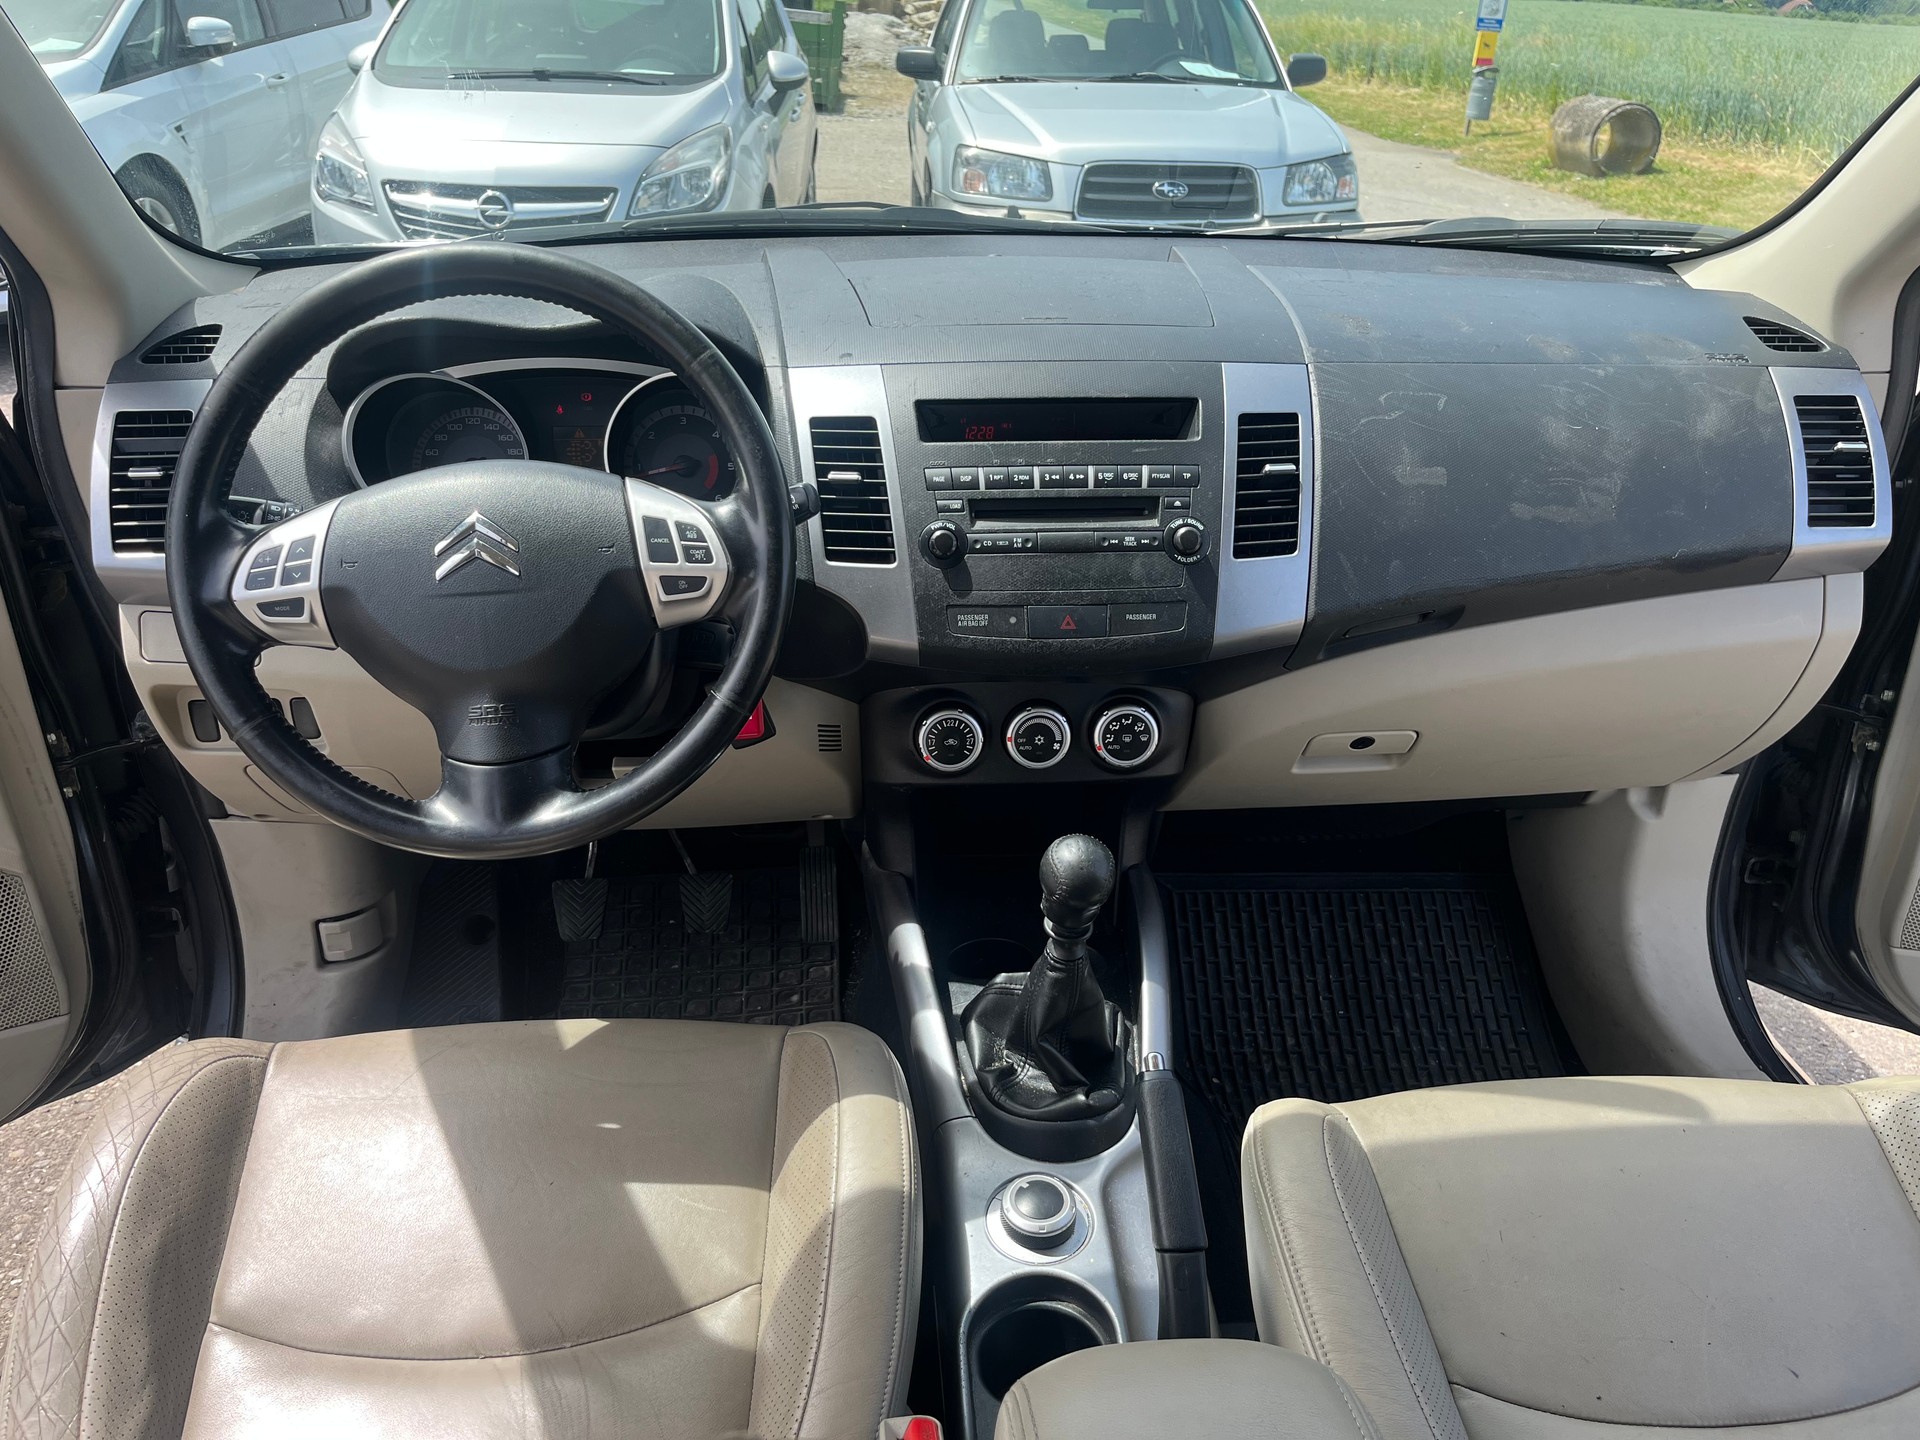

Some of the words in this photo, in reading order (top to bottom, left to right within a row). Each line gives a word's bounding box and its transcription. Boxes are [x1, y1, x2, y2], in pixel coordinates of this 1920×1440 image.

[680, 417, 687, 425] 3
[712, 430, 720, 438] 4
[468, 703, 515, 716] SRS
[946, 719, 955, 727] 22
